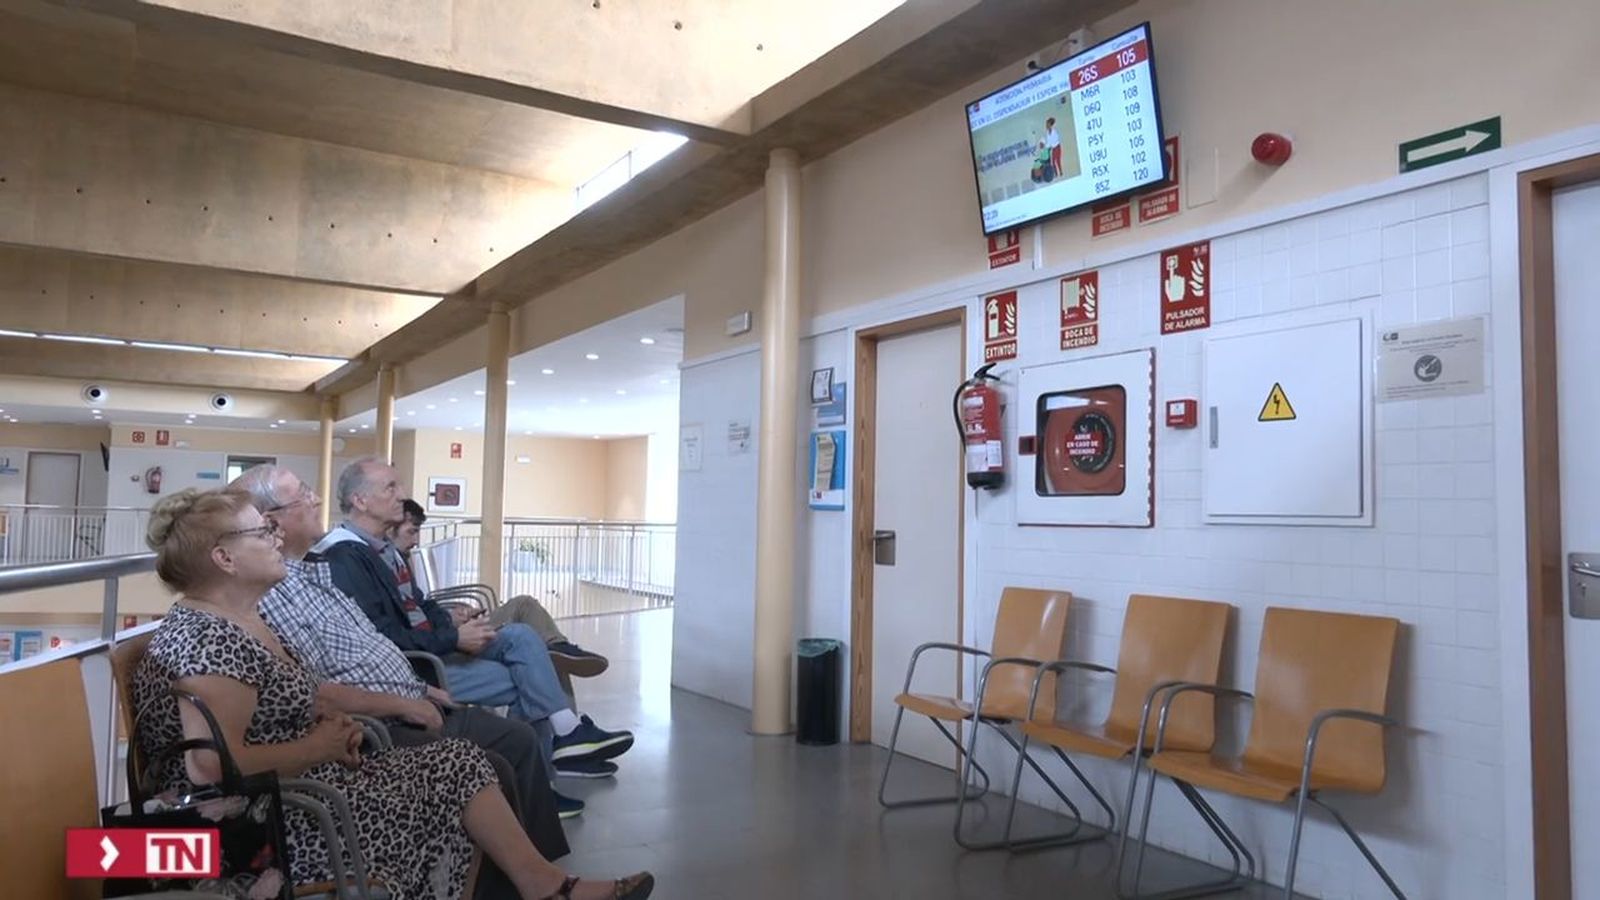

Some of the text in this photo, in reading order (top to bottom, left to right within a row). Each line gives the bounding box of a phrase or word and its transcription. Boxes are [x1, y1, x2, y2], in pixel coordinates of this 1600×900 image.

[1078, 48, 1136, 85] 26S 105
[1081, 69, 1136, 100] M6R 103
[1084, 85, 1138, 116] D6Q 108
[1087, 102, 1140, 130] 47U 109
[1088, 118, 1142, 147] P5Y 103
[1089, 134, 1144, 163] U9U 105
[1092, 151, 1146, 178] R5X 102
[1095, 167, 1148, 194] 85Z 120
[992, 253, 1017, 266] EXTINTOR
[1164, 316, 1206, 332] DE ALARMA
[1166, 307, 1205, 321] PULSADOR
[1063, 336, 1097, 348] INCENDIO
[1065, 326, 1094, 339] BOCA DE
[986, 343, 1016, 359] EXTINTOR
[1075, 440, 1090, 448] CASO
